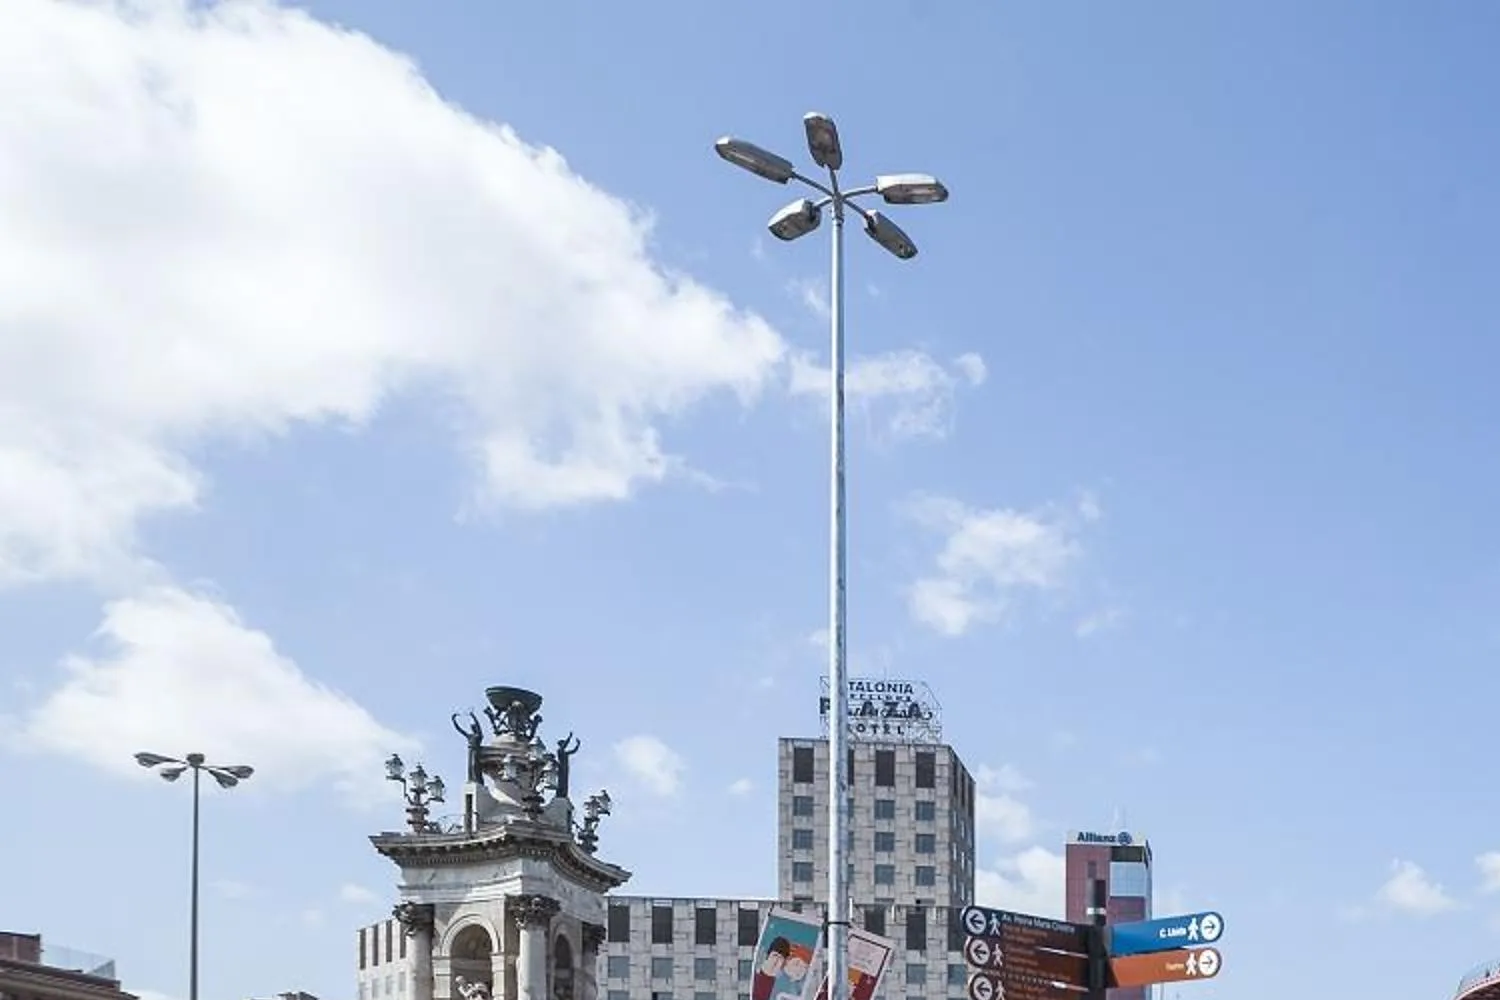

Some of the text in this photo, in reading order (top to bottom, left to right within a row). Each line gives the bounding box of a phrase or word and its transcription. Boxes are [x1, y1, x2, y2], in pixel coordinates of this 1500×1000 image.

[847, 680, 914, 695] TALONIA
[820, 697, 921, 719] PAZA
[1077, 831, 1117, 842] Allianz
